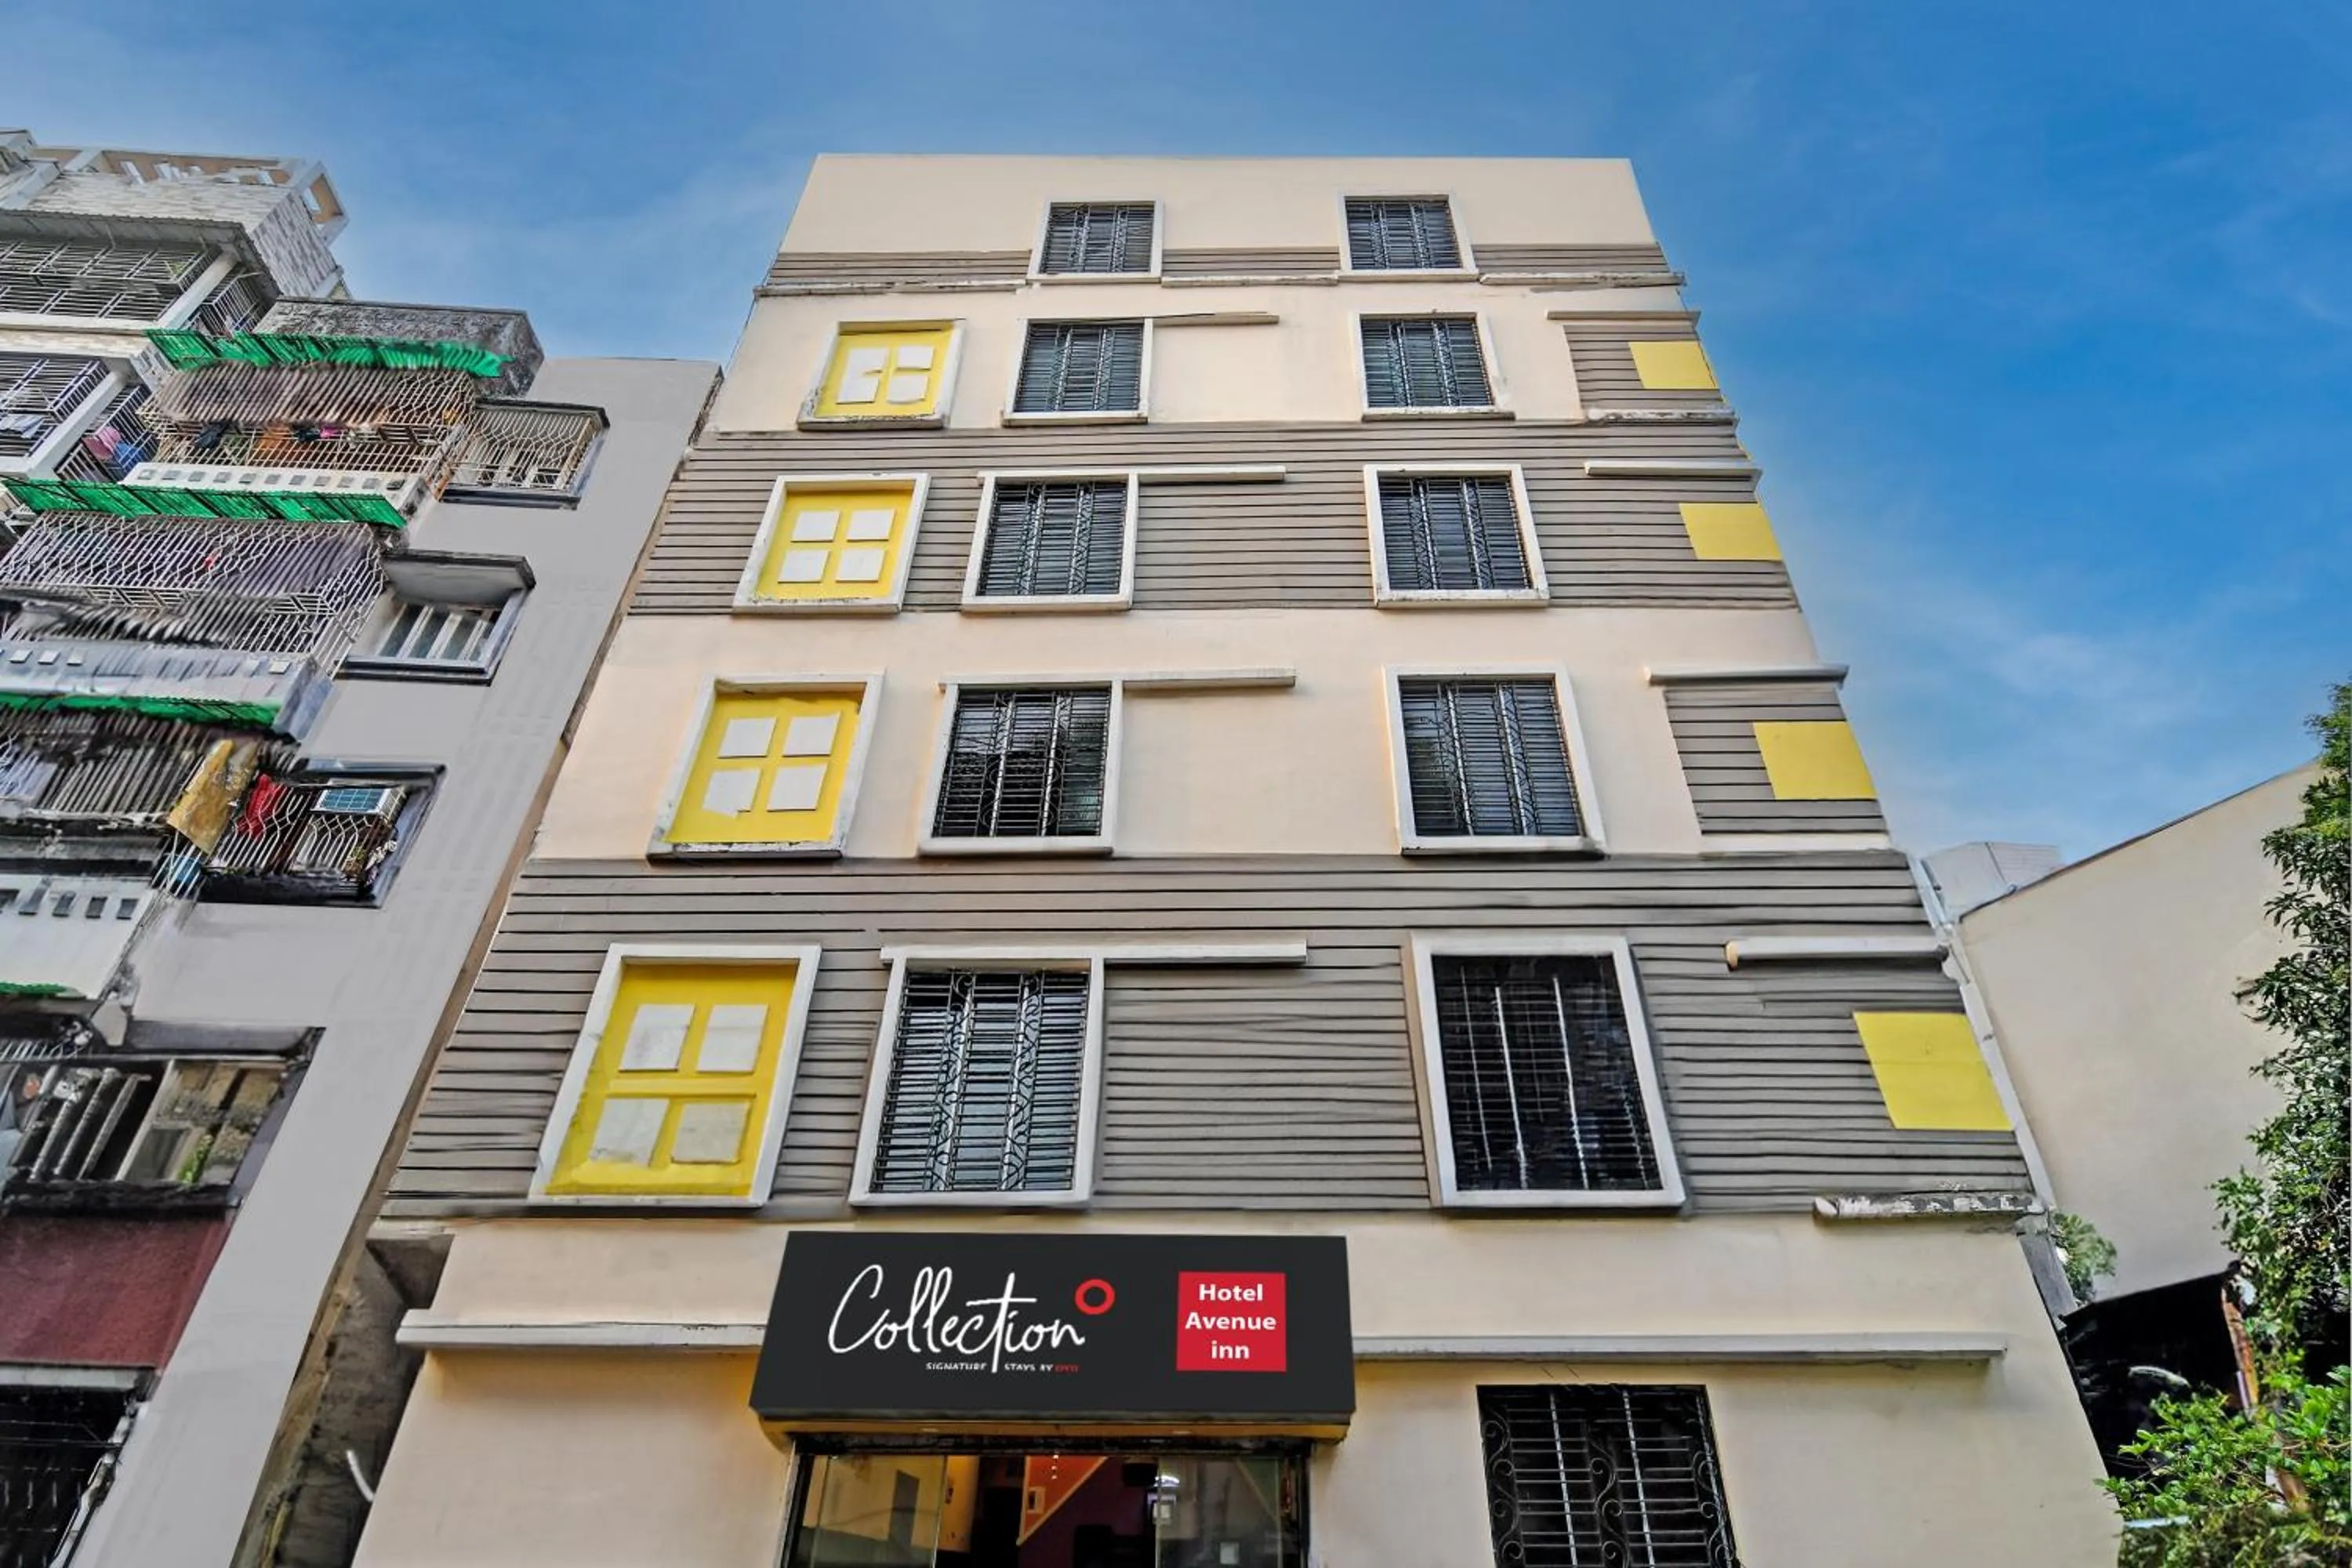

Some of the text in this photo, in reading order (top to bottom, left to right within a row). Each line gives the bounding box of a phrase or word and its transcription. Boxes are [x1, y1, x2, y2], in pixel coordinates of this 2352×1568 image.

[1199, 1283, 1263, 1301] Hotel
[828, 1264, 1086, 1373] Collection
[1185, 1312, 1276, 1330] Avenue
[1211, 1340, 1250, 1359] inn
